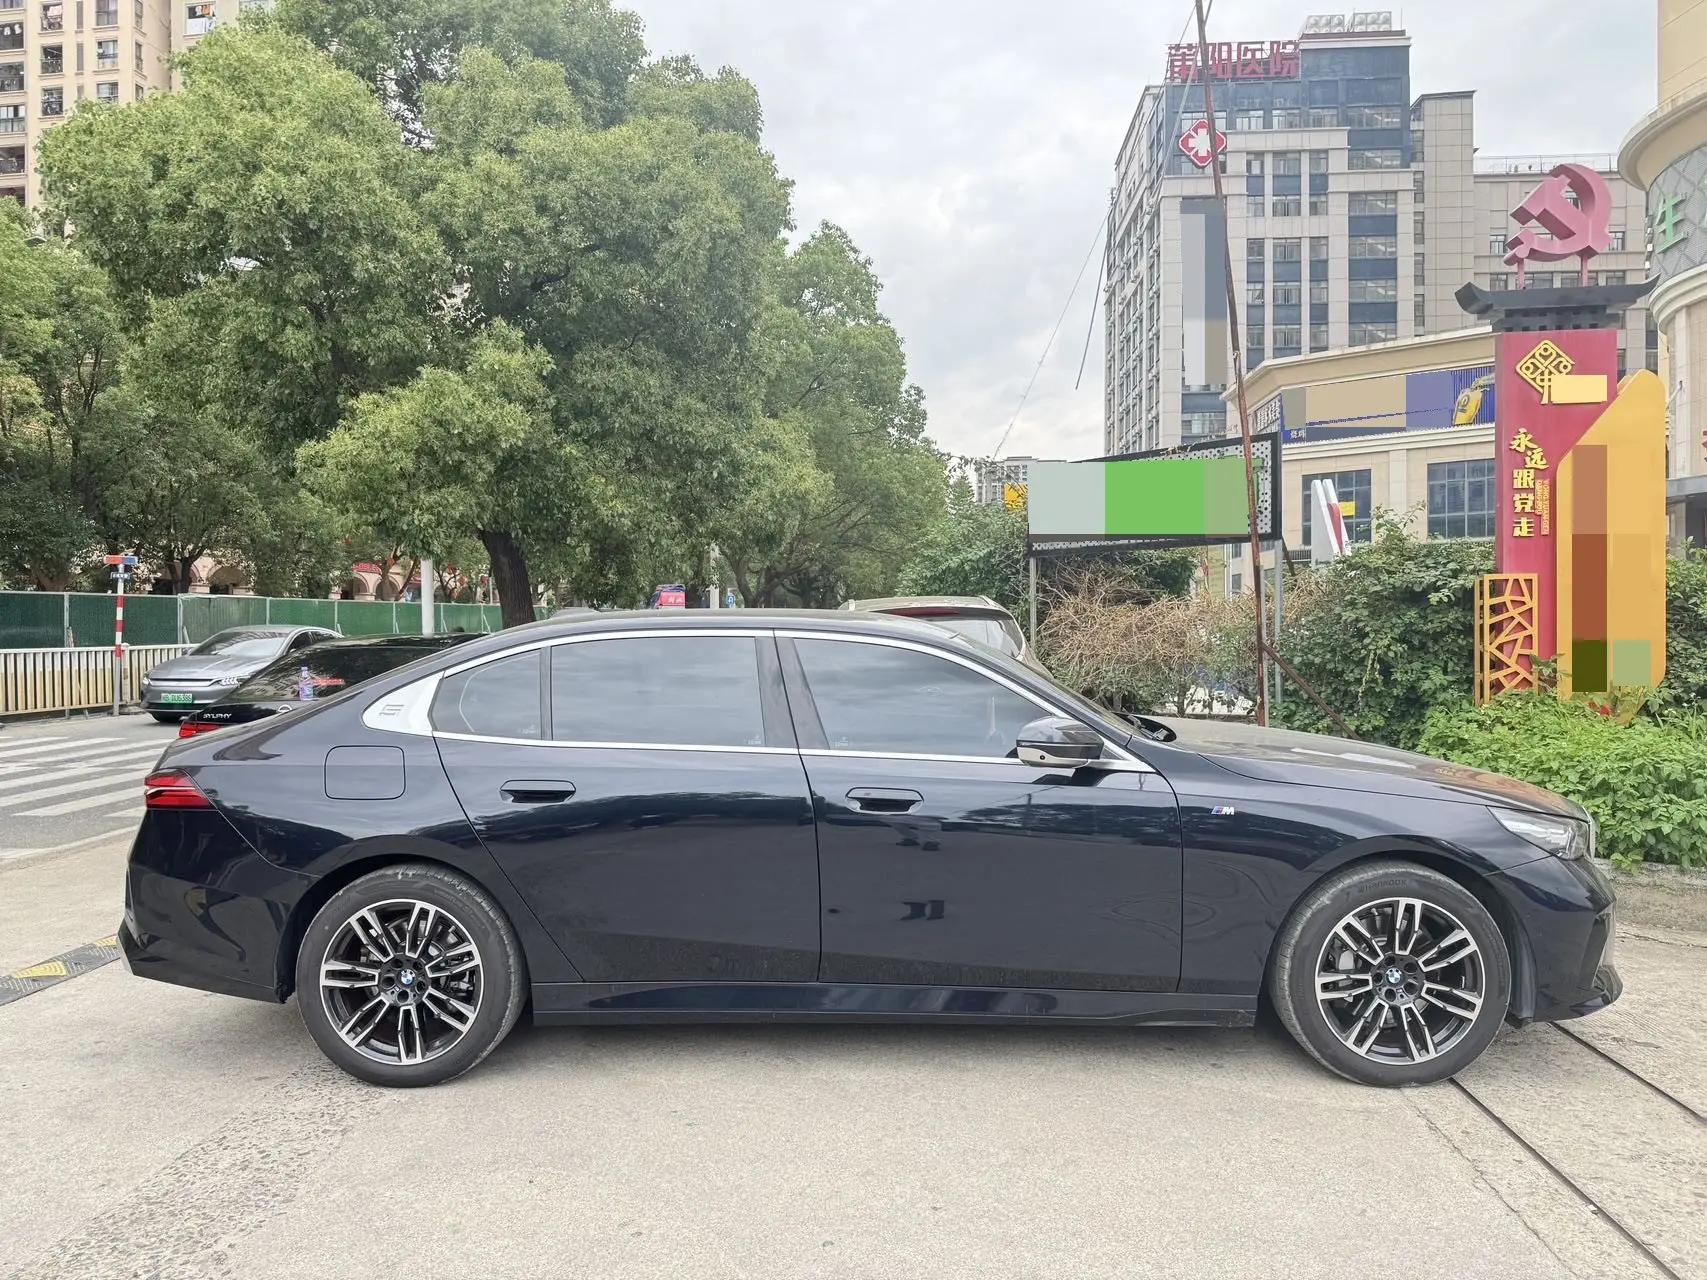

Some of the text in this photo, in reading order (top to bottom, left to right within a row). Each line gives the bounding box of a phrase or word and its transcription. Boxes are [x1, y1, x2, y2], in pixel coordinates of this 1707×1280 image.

[1509, 427, 1549, 537] 永远跟党走
